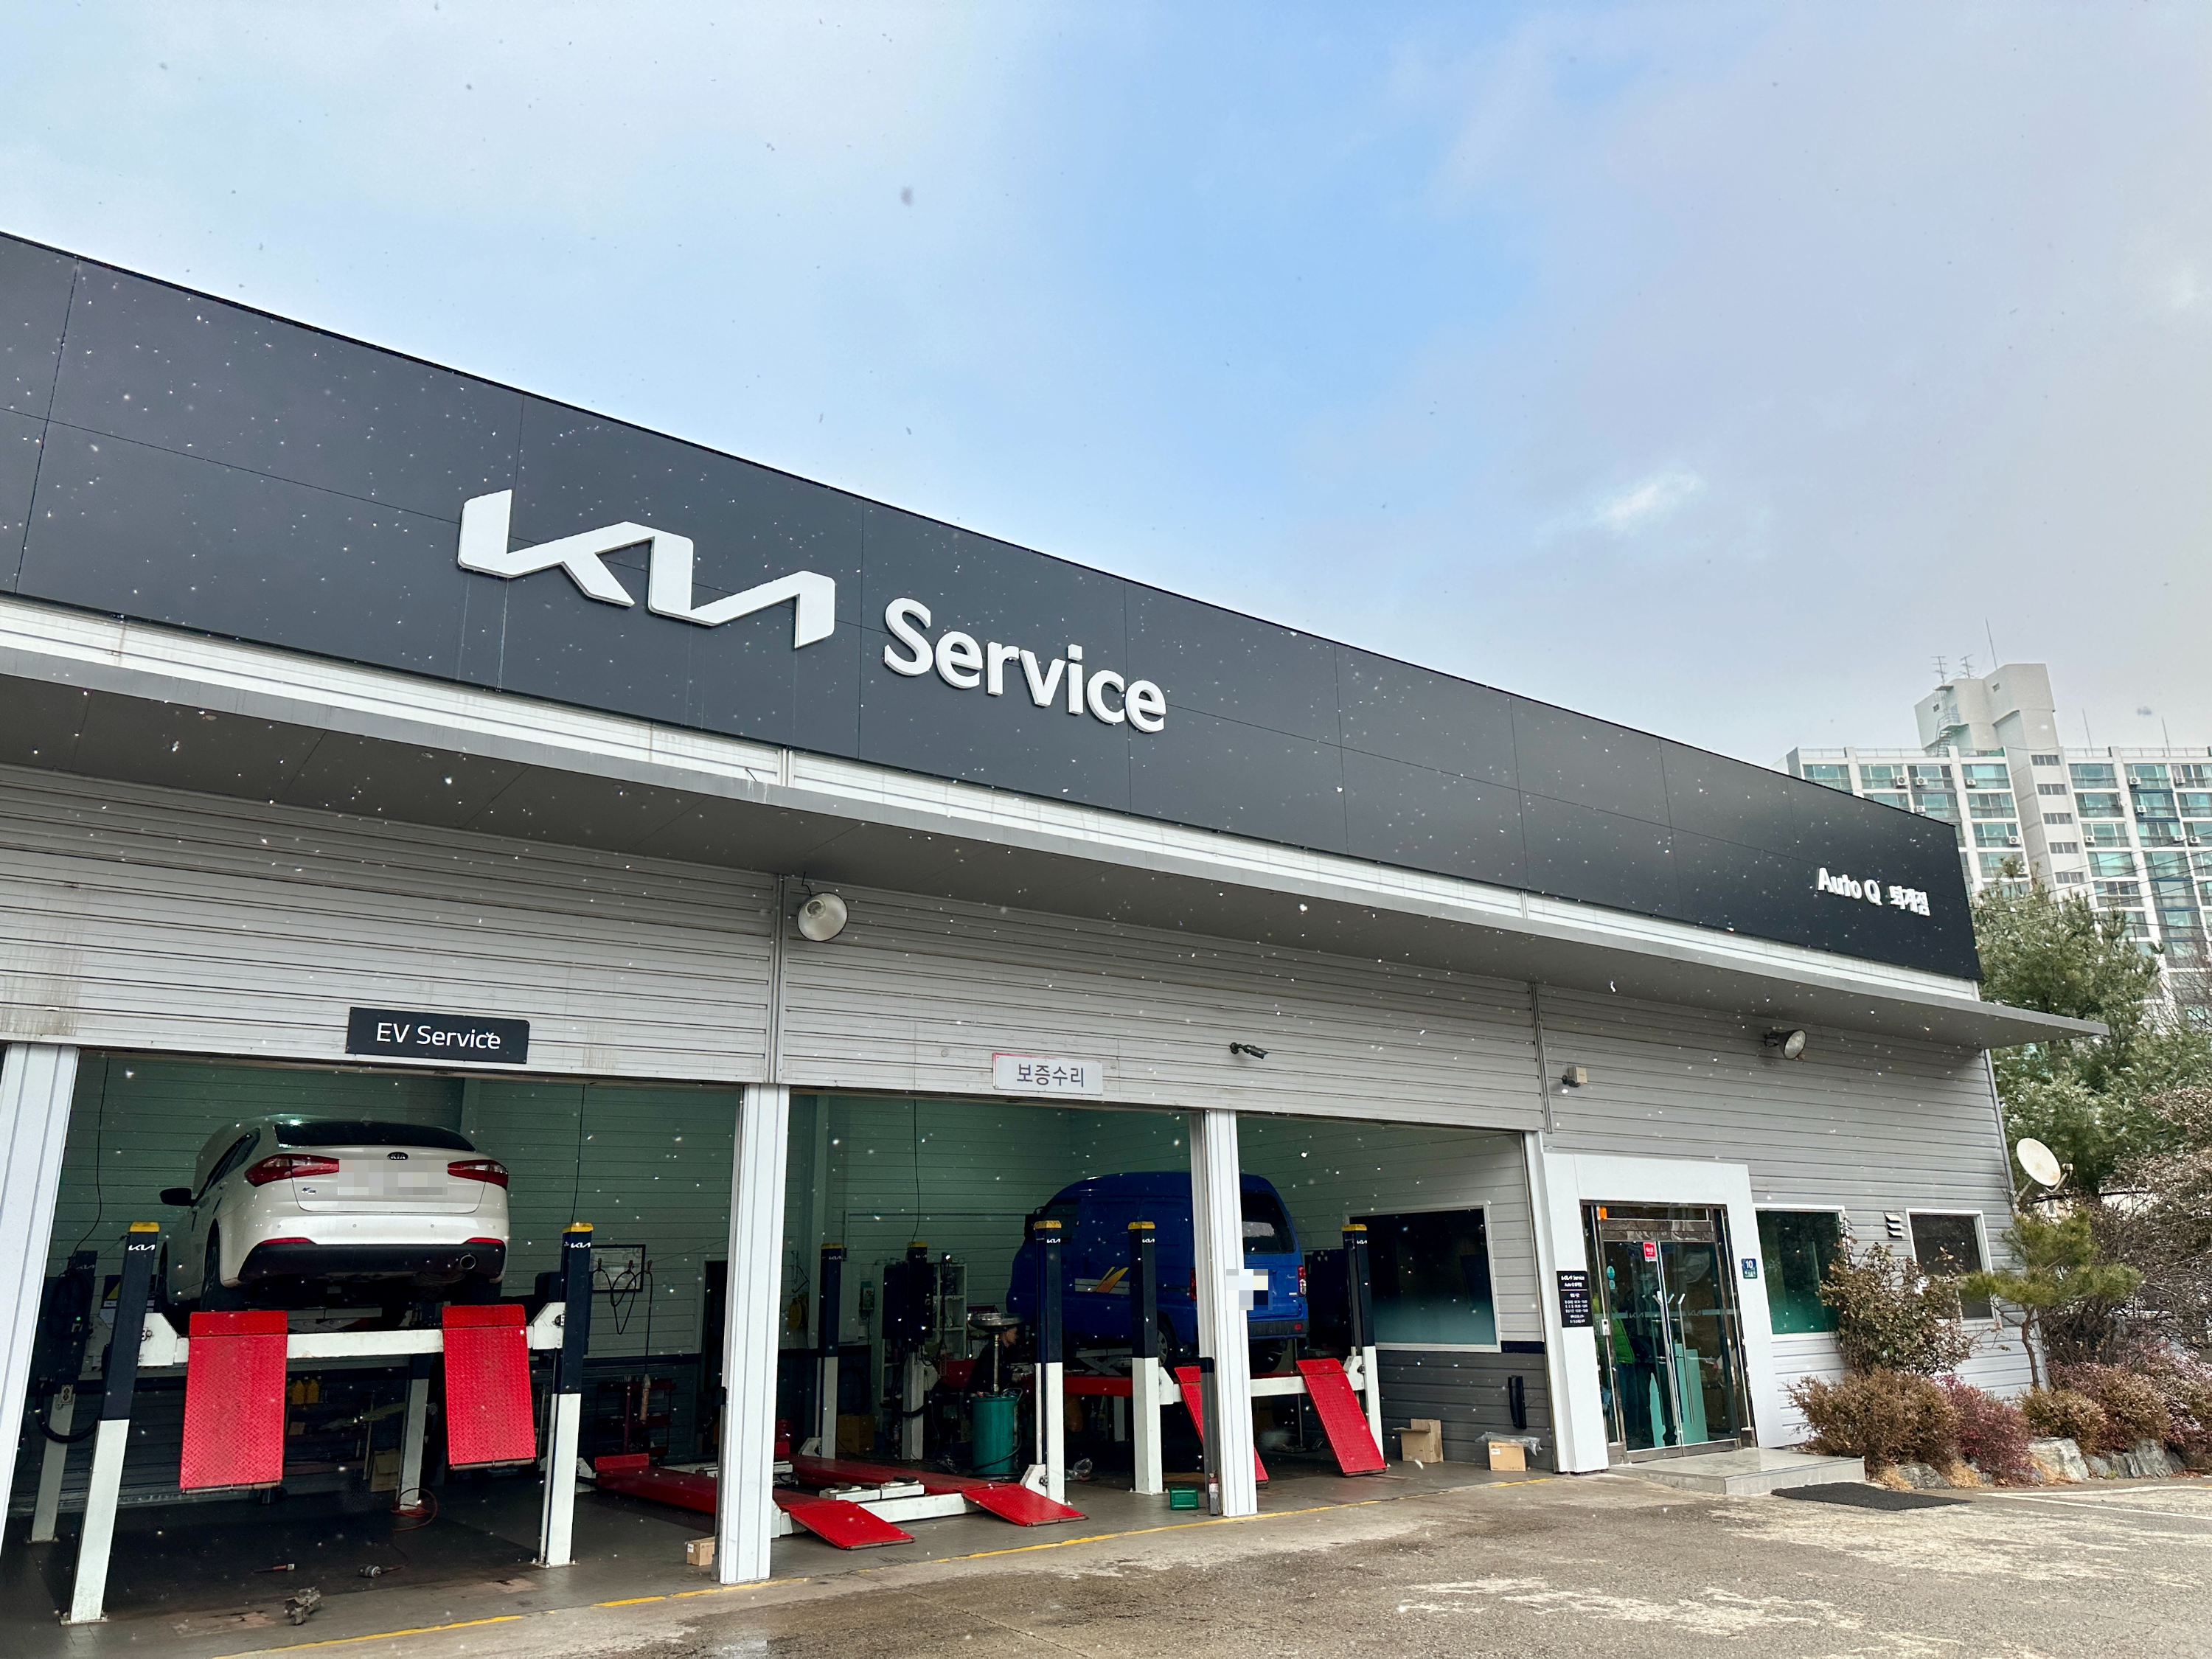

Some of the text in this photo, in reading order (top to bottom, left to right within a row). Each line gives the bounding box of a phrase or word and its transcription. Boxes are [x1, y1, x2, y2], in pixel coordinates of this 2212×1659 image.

[458, 489, 1166, 733] KIA Service
[1818, 867, 1863, 900] Auto
[1863, 879, 1882, 906] Q
[376, 1022, 501, 1049] EV Service
[1017, 1063, 1084, 1088] 보증수리
[1745, 1259, 1753, 1269] 10
